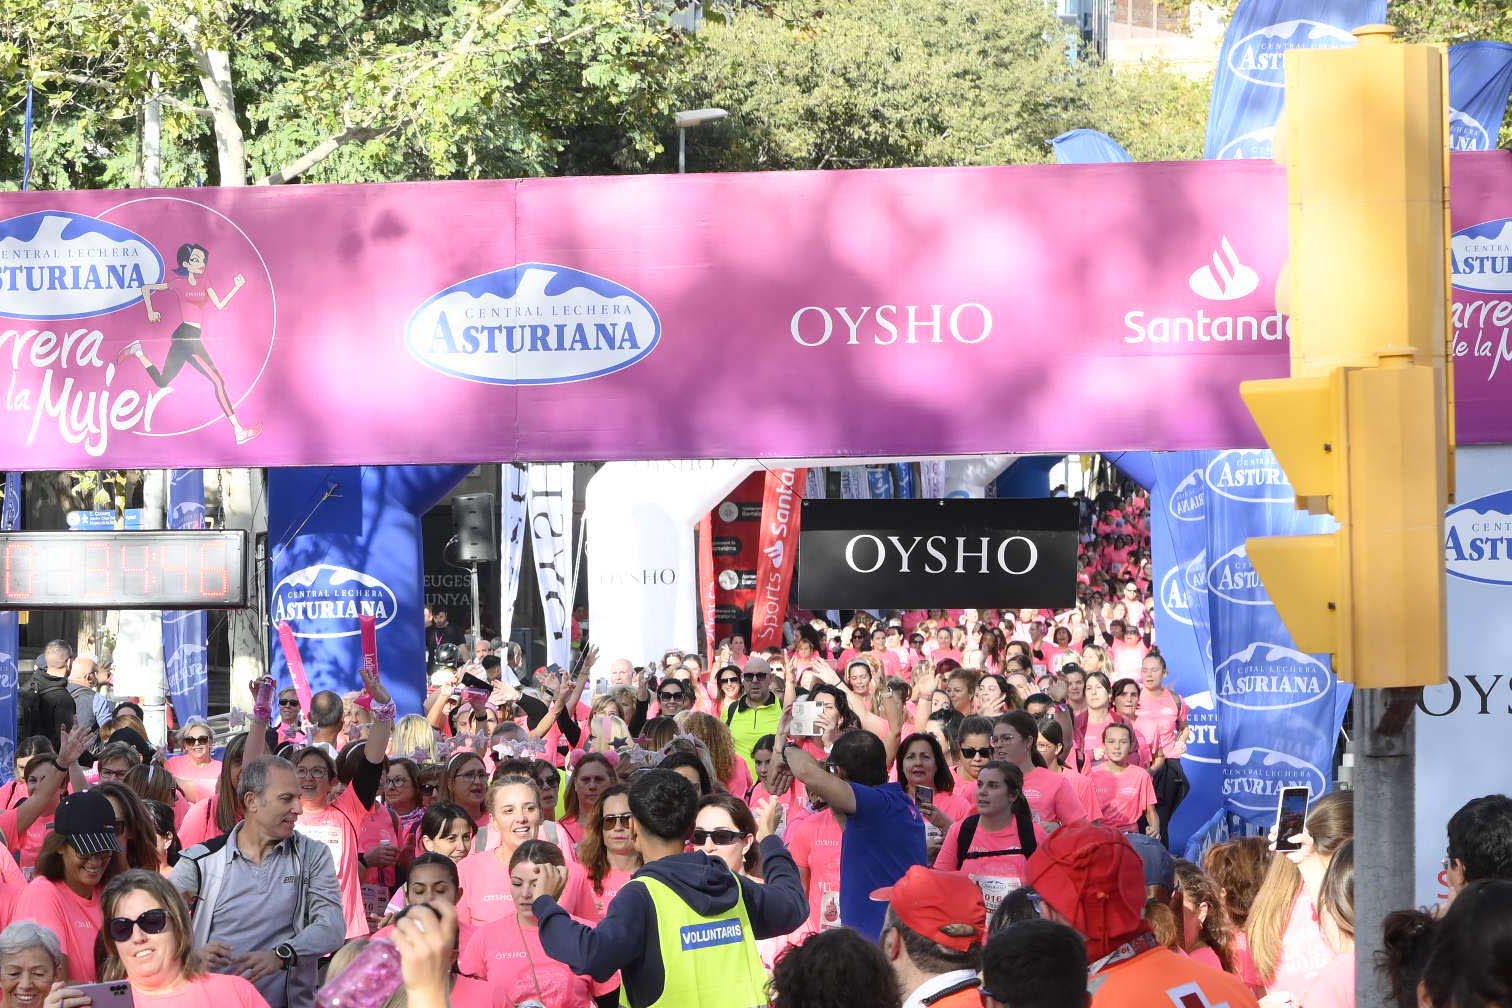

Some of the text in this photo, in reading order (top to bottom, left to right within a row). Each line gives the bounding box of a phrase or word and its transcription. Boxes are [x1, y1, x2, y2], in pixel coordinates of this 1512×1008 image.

[1238, 45, 1285, 71] AST
[68, 246, 140, 259] LECHERA
[465, 304, 632, 318] CENTRAL LECHERA
[790, 302, 994, 347] OYSHO
[428, 310, 641, 354] ASTURIANA
[1123, 311, 1291, 344] Santand
[5, 369, 32, 411] la
[26, 364, 176, 457] Mujer
[845, 534, 1038, 575] OYSHO
[288, 589, 383, 599] CENTRAL LECHERA
[275, 595, 388, 622] ASTURIANA
[682, 925, 742, 944] VOLUNTARIS
